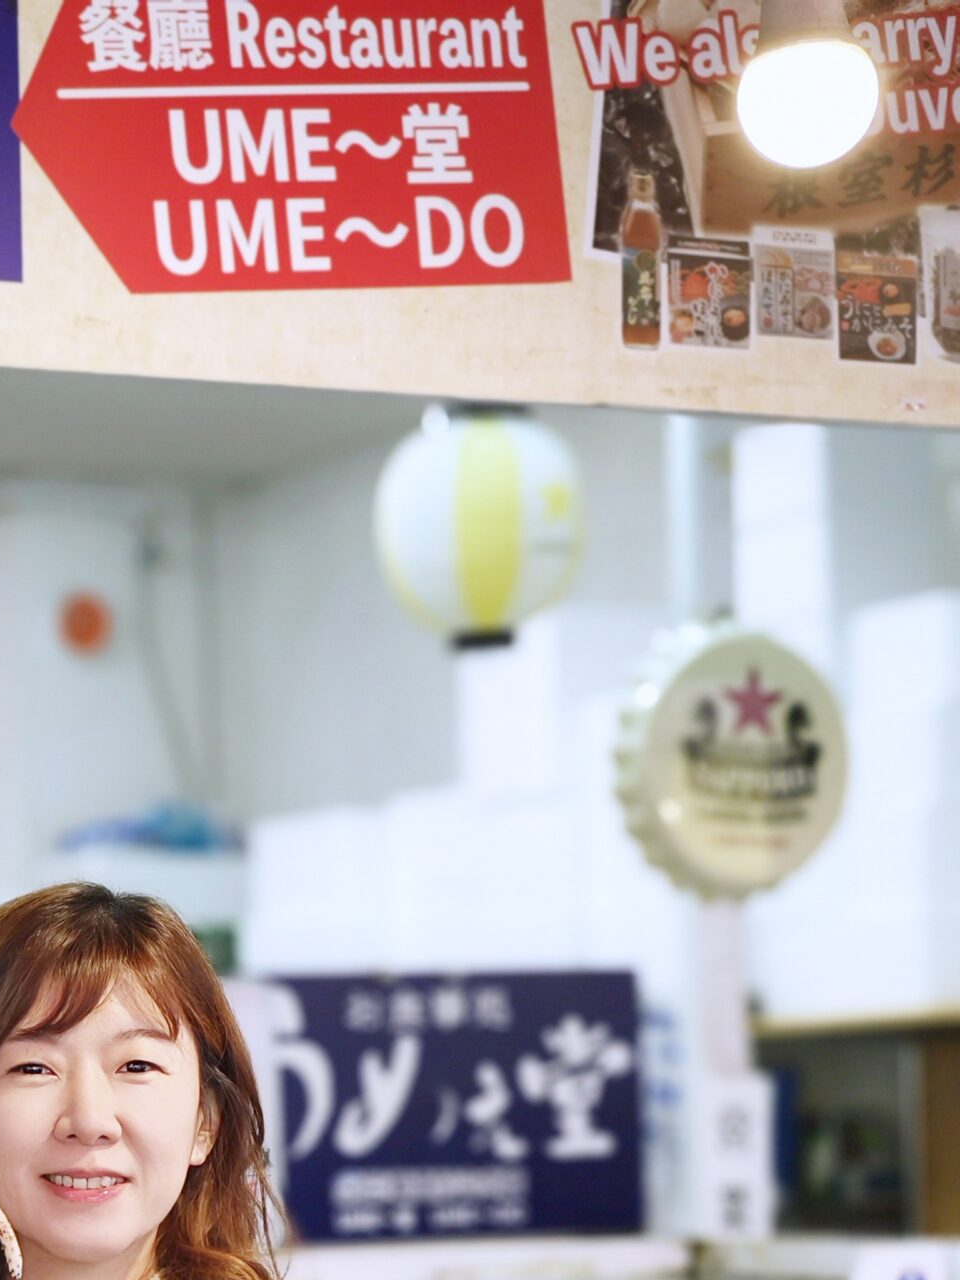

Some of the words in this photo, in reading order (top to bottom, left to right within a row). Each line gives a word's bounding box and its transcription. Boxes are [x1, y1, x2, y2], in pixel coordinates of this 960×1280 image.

[78, 0, 214, 72] 餐廳
[227, 5, 528, 69] Restaurant
[575, 22, 677, 84] We
[691, 15, 759, 79] al
[852, 15, 956, 76] arry
